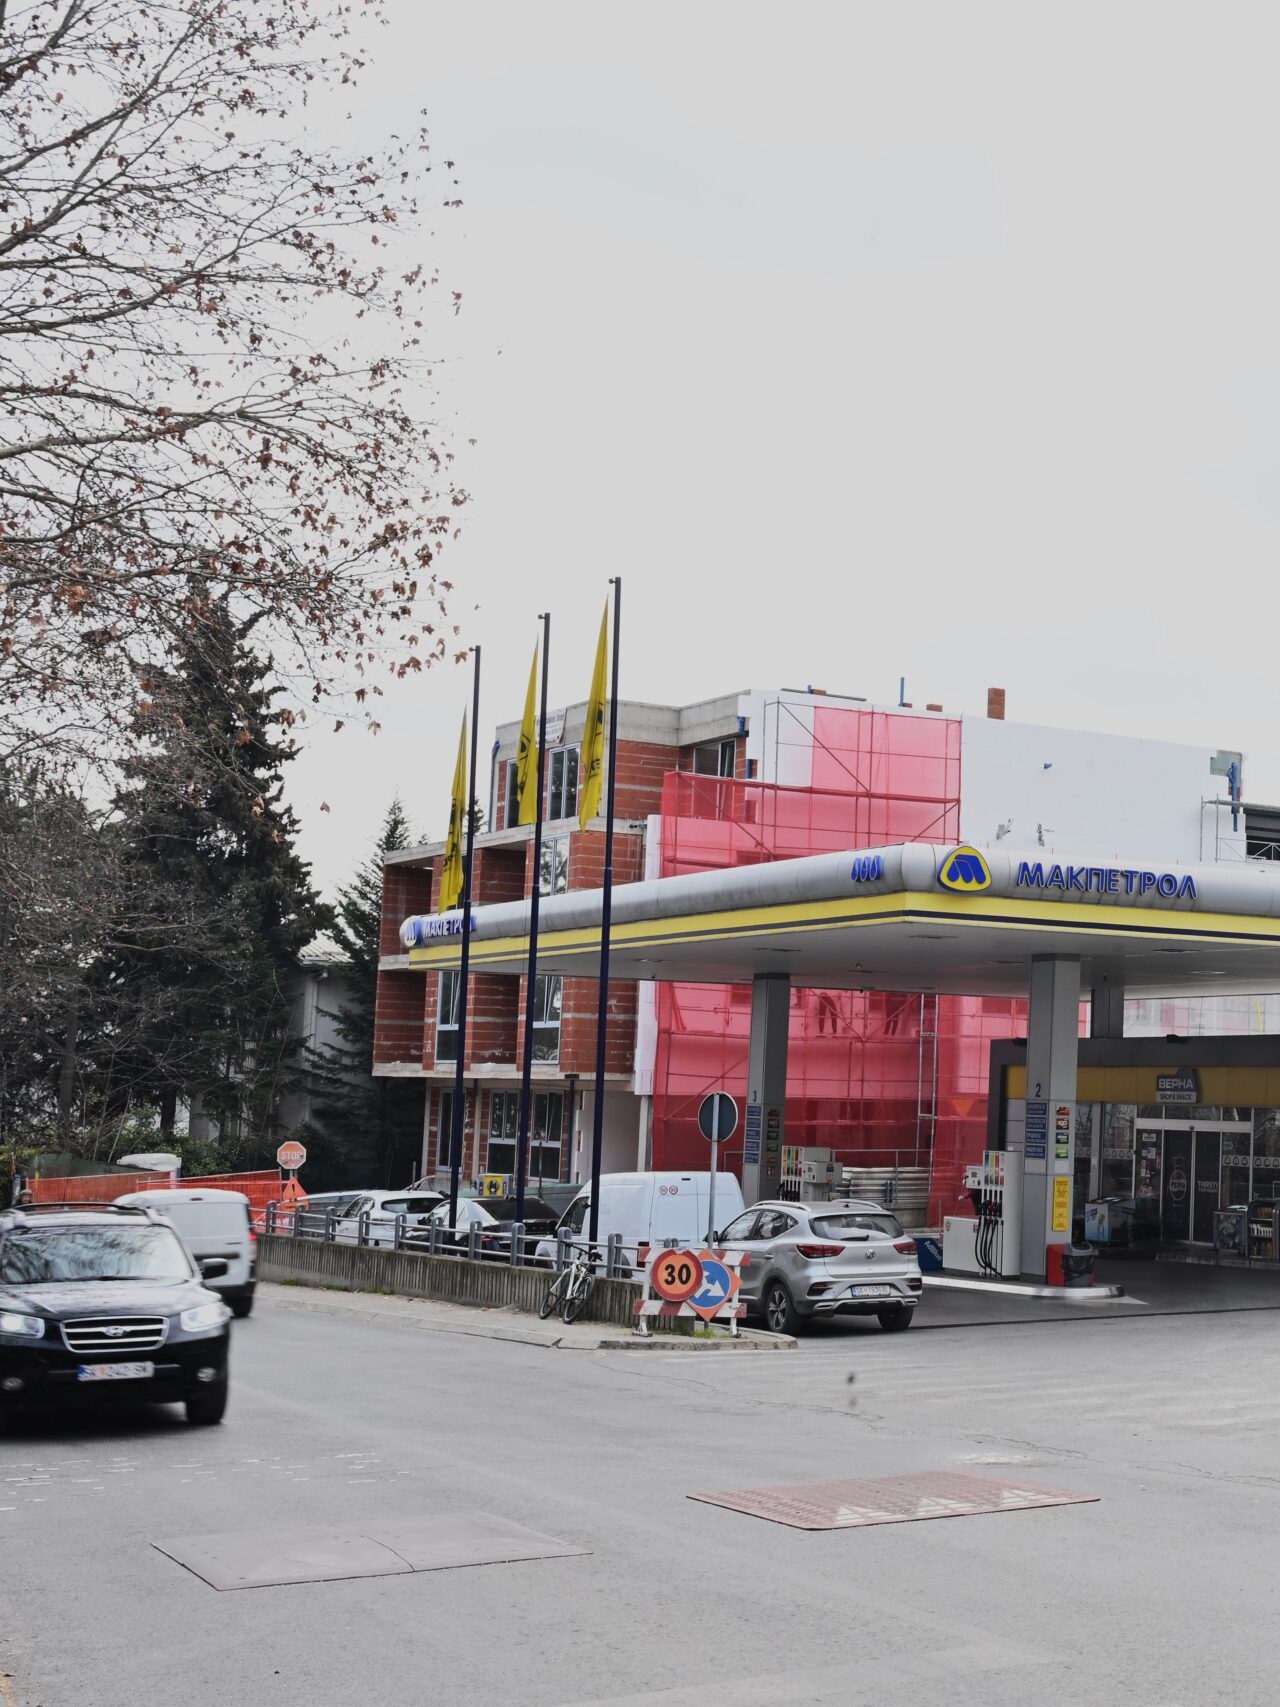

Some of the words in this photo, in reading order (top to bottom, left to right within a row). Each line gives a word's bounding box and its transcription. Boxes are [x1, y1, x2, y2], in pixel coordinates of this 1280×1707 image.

[1017, 860, 1198, 899] МАКПЕТРОЛ
[424, 916, 477, 938] МАКПЕТР
[752, 1090, 757, 1102] 3
[1035, 1083, 1042, 1098] 2
[281, 1151, 304, 1161] STOP
[664, 1263, 692, 1286] 30
